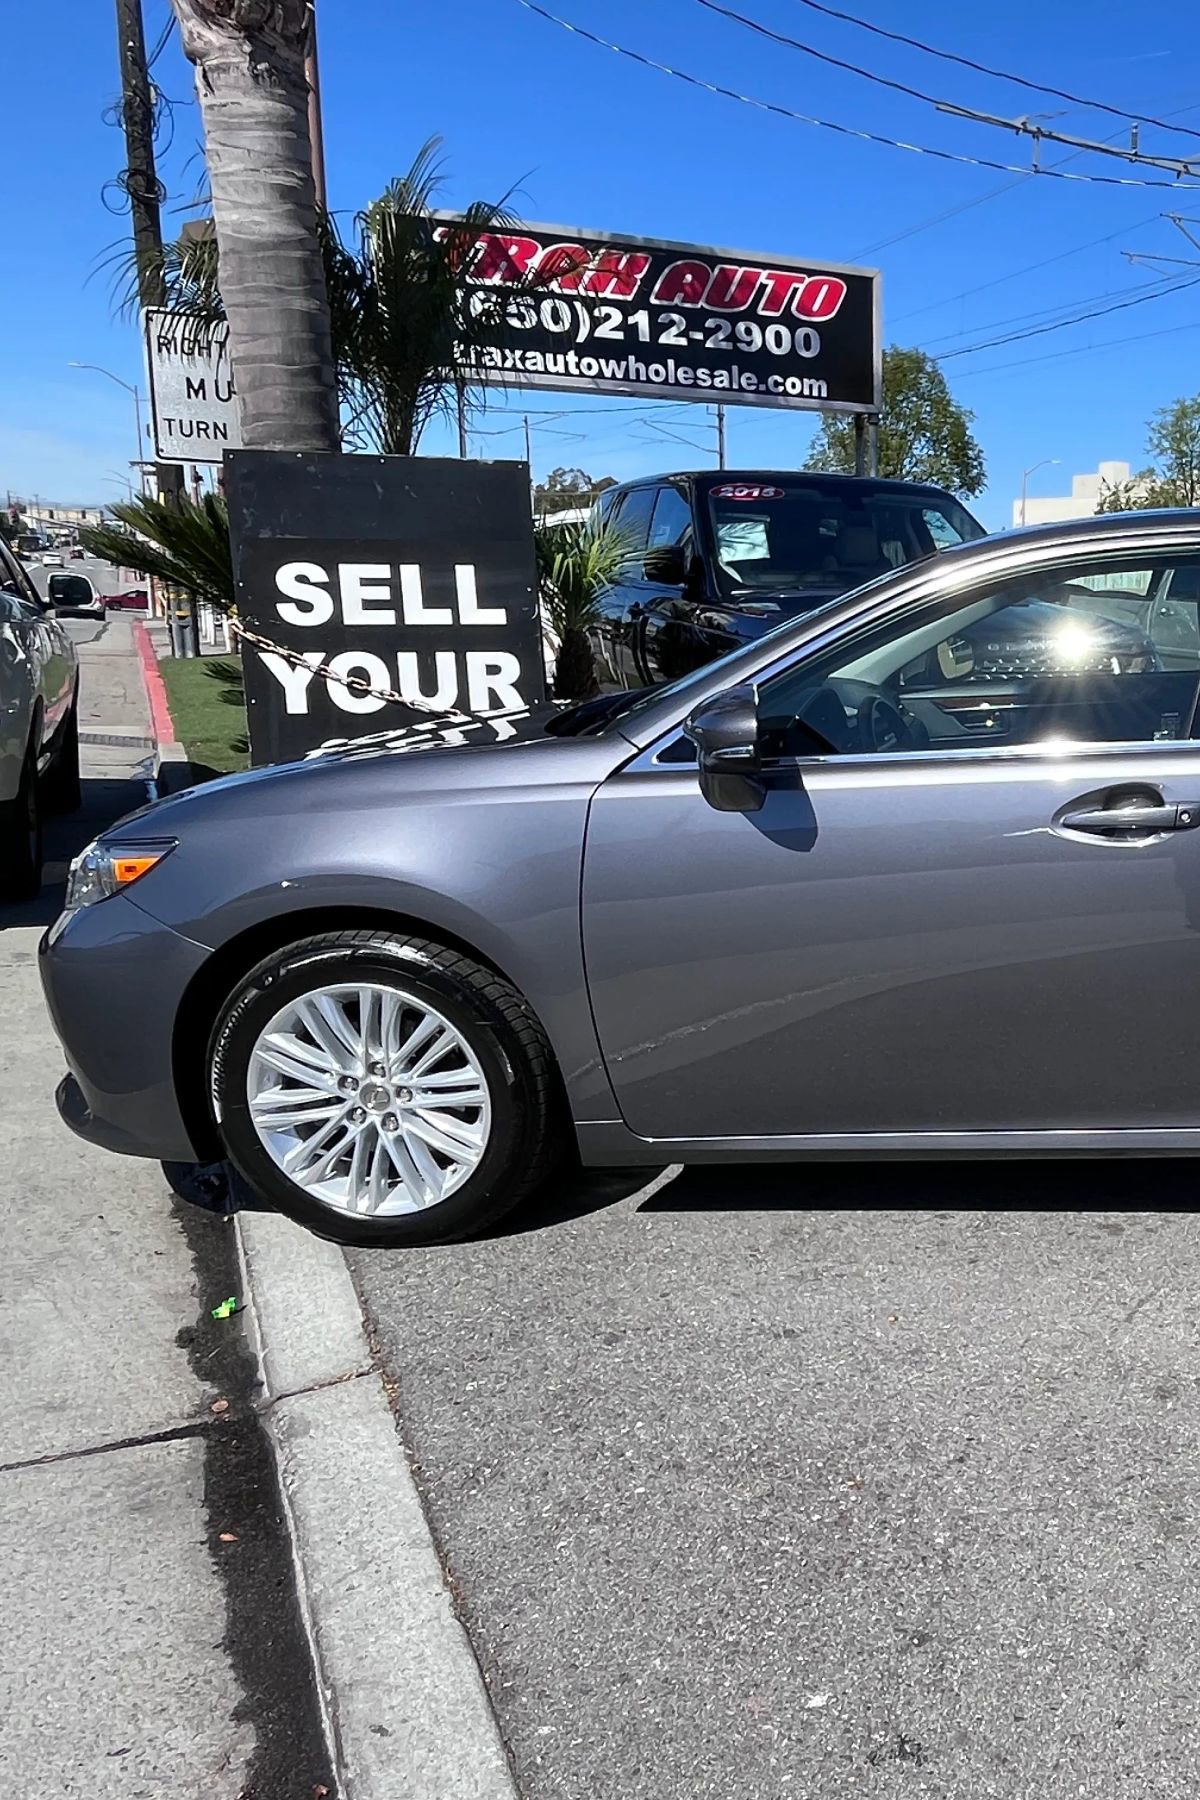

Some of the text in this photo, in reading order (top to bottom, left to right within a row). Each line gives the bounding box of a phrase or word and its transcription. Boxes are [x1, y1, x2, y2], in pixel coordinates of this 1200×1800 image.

[650, 260, 847, 322] AUTO
[156, 334, 228, 359] RIGHT
[185, 376, 233, 403] MU
[162, 417, 228, 441] TURN
[719, 486, 776, 497] 2015
[274, 561, 508, 627] SELL
[257, 650, 528, 715] YOUR
